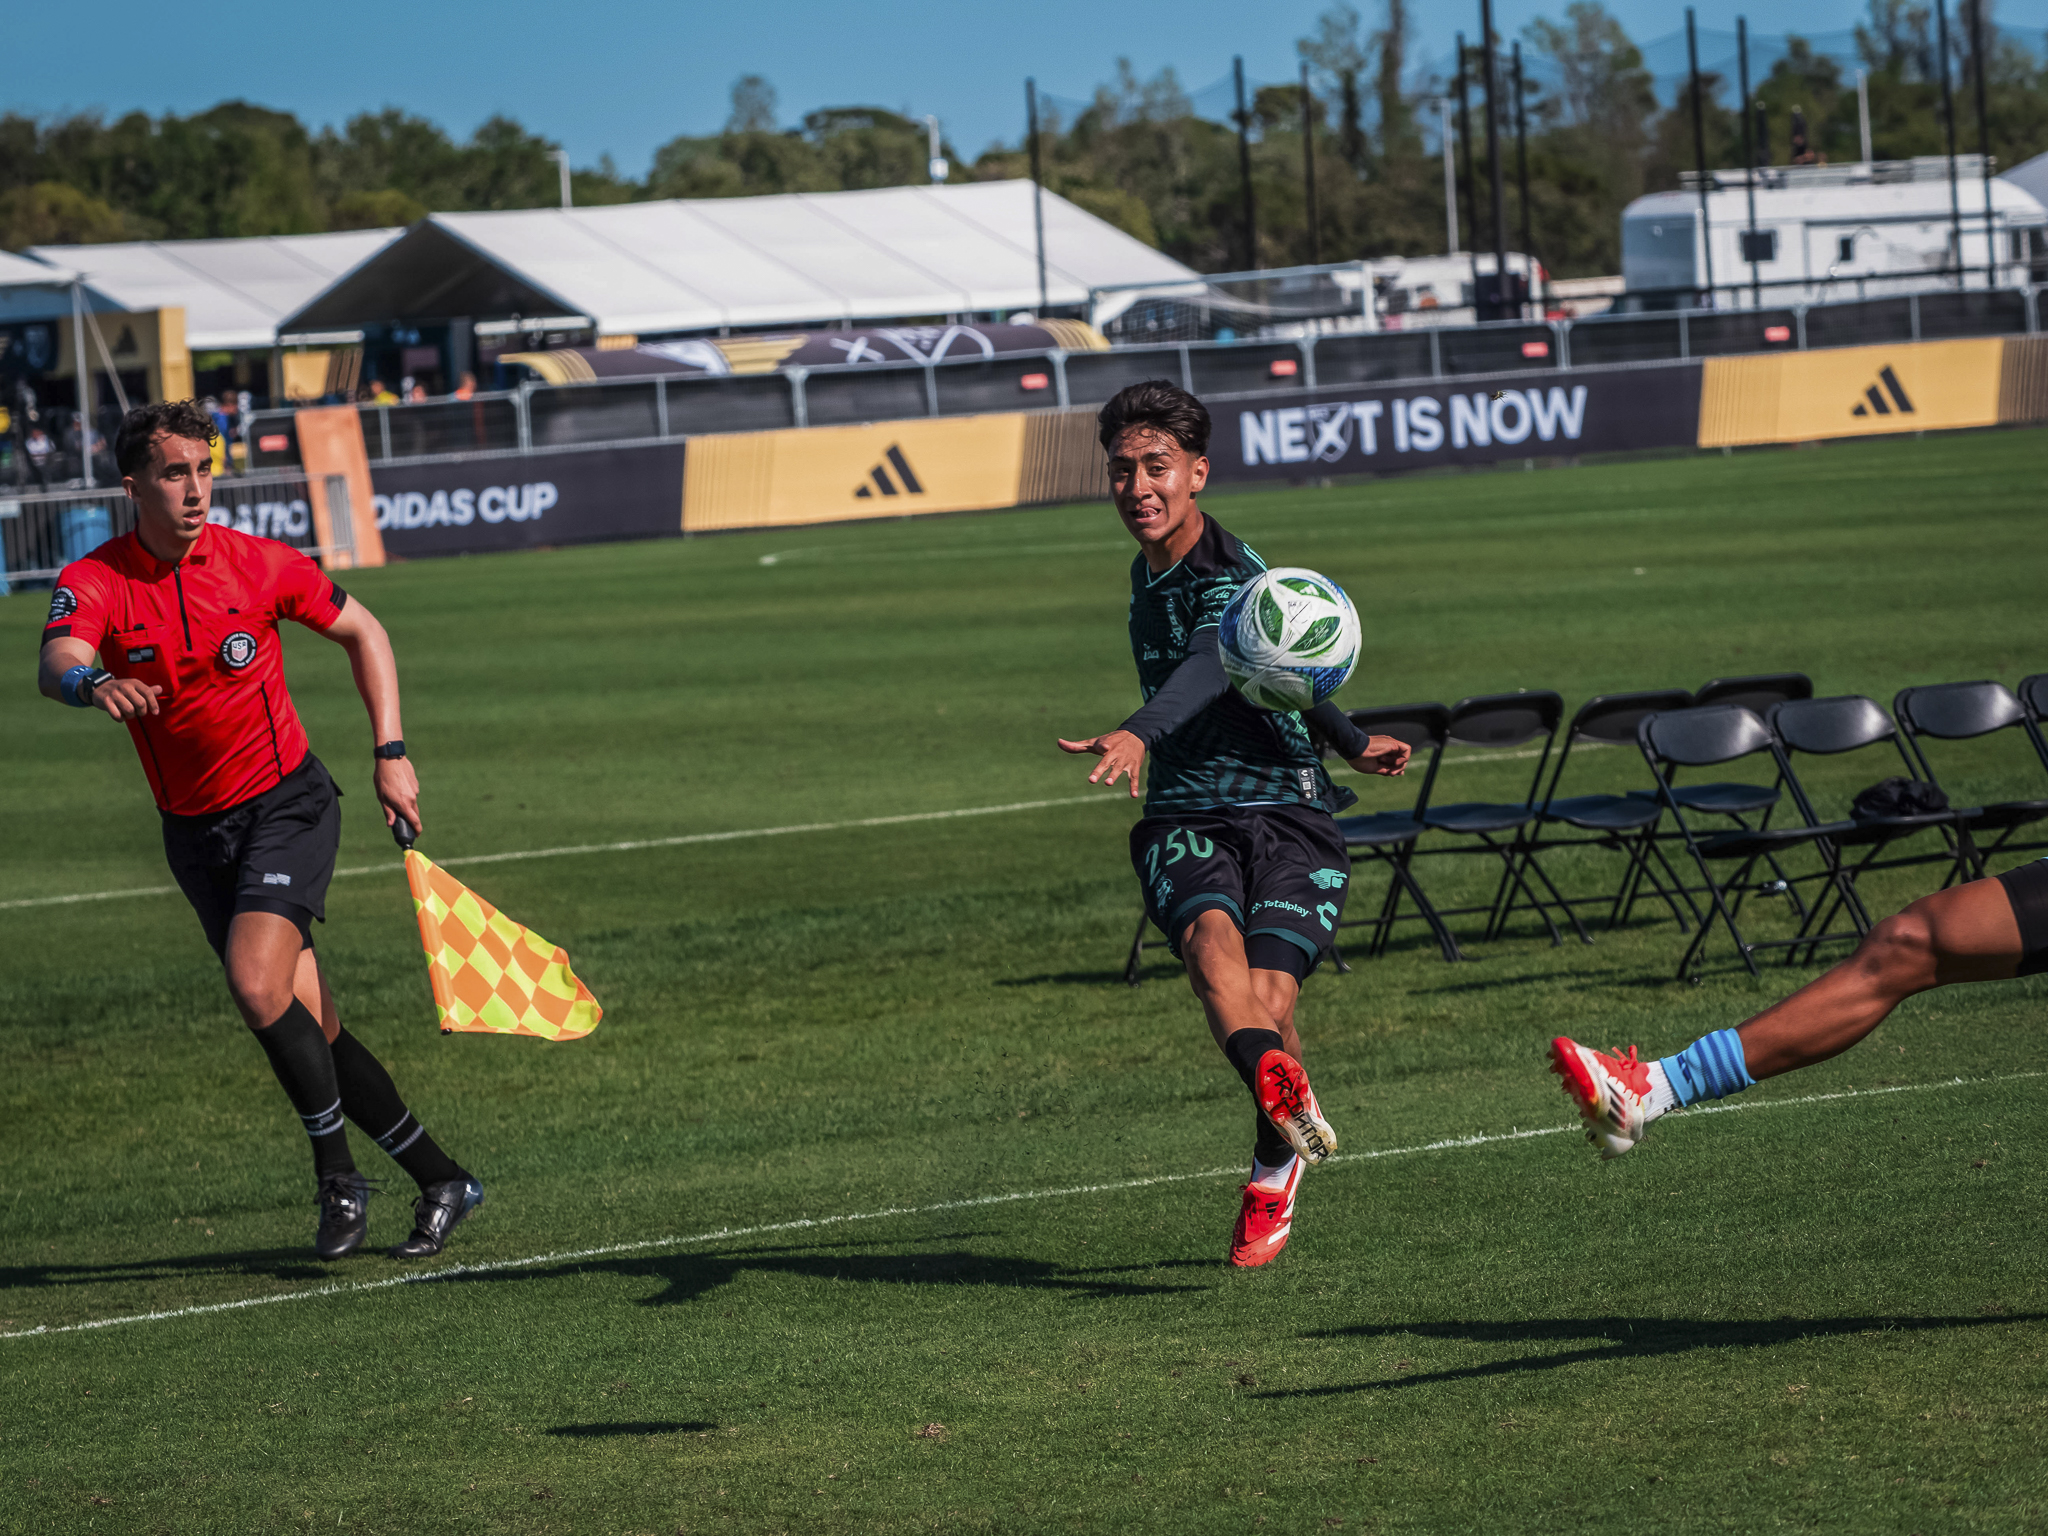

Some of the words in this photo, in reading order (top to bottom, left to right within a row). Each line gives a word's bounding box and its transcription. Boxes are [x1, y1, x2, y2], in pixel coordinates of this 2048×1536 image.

[1239, 400, 1383, 466] NEXT
[1391, 396, 1445, 453] IS
[1450, 385, 1588, 449] NOW
[371, 487, 475, 531] DIDAS
[477, 481, 559, 525] CUP
[232, 641, 247, 650] USA
[1145, 827, 1214, 887] 250
[1264, 899, 1310, 918] Totalplay
